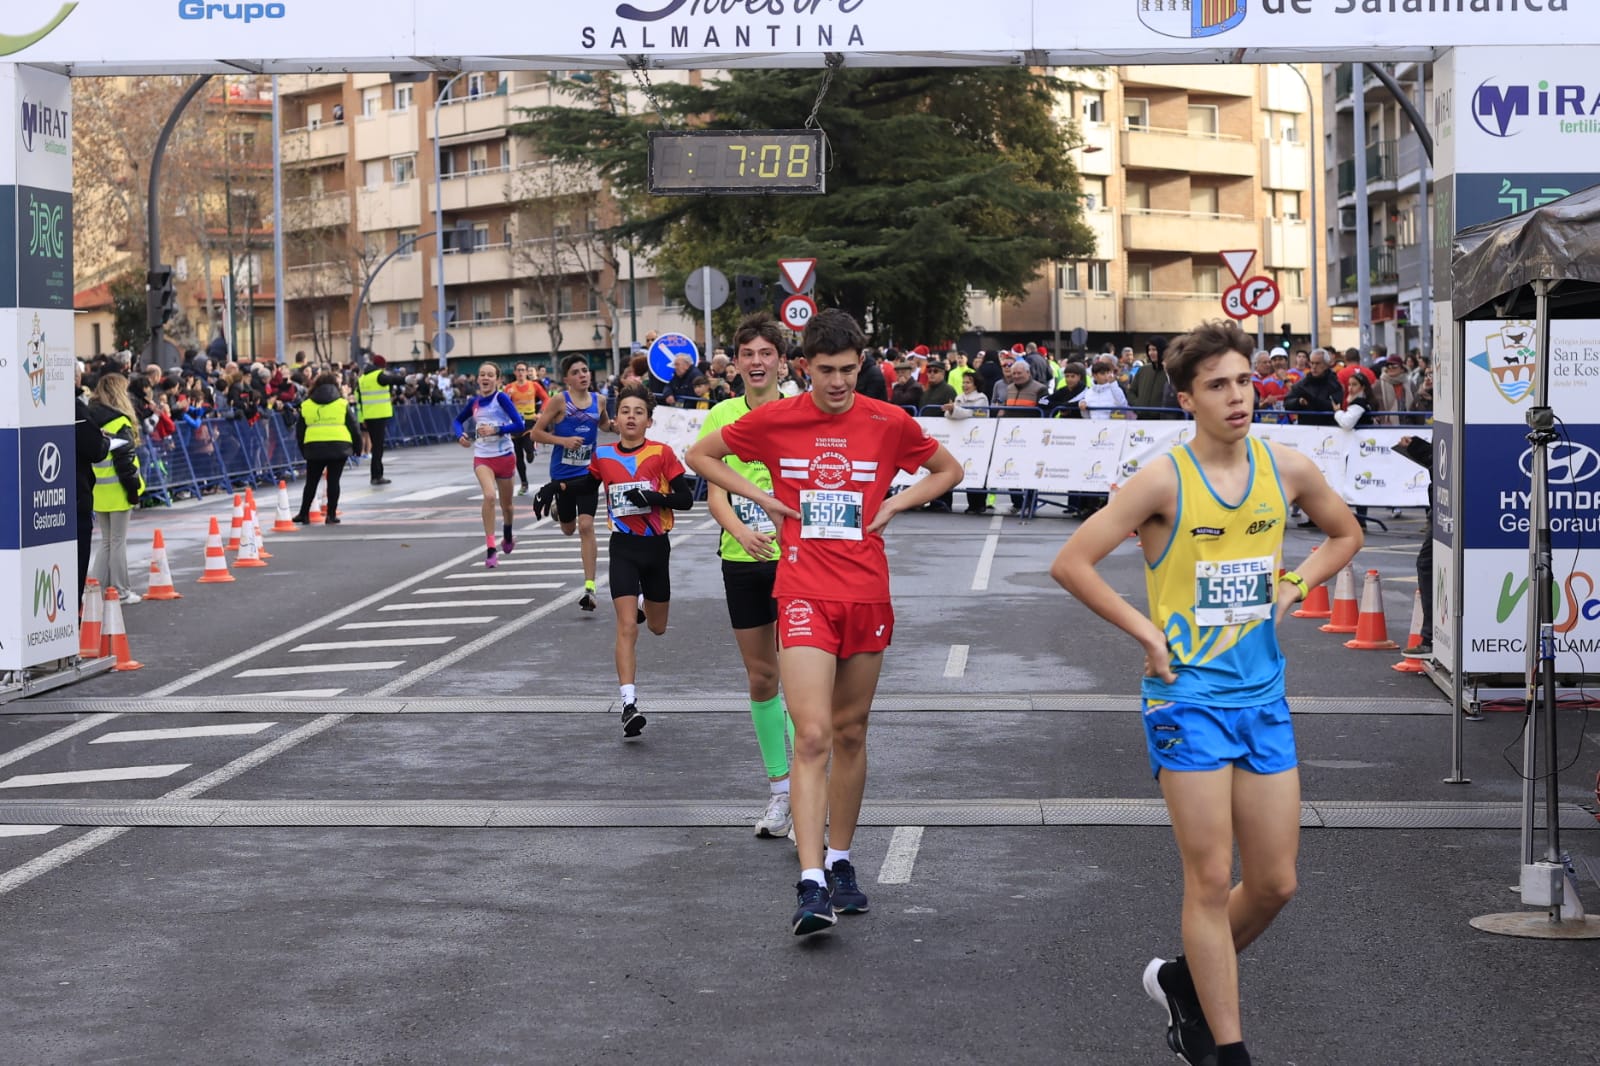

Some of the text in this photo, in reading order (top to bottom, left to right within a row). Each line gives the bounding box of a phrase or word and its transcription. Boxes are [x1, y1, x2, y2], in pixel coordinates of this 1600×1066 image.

[178, 0, 286, 23] Grupo
[581, 24, 865, 49] SALMANTINA
[1560, 119, 1600, 133] fertili
[728, 144, 810, 178] 7:08
[1229, 296, 1239, 308] 3
[789, 307, 808, 320] 30
[1554, 347, 1600, 361] San Es
[1553, 363, 1570, 376] de
[33, 488, 66, 508] HYUNDAI
[816, 492, 857, 503] SETEL
[33, 511, 66, 530] Gestorauto
[809, 502, 846, 523] 5512
[1220, 562, 1267, 575] SETEL
[1208, 576, 1258, 603] 5552
[27, 624, 74, 648] MERCASALAMANCA
